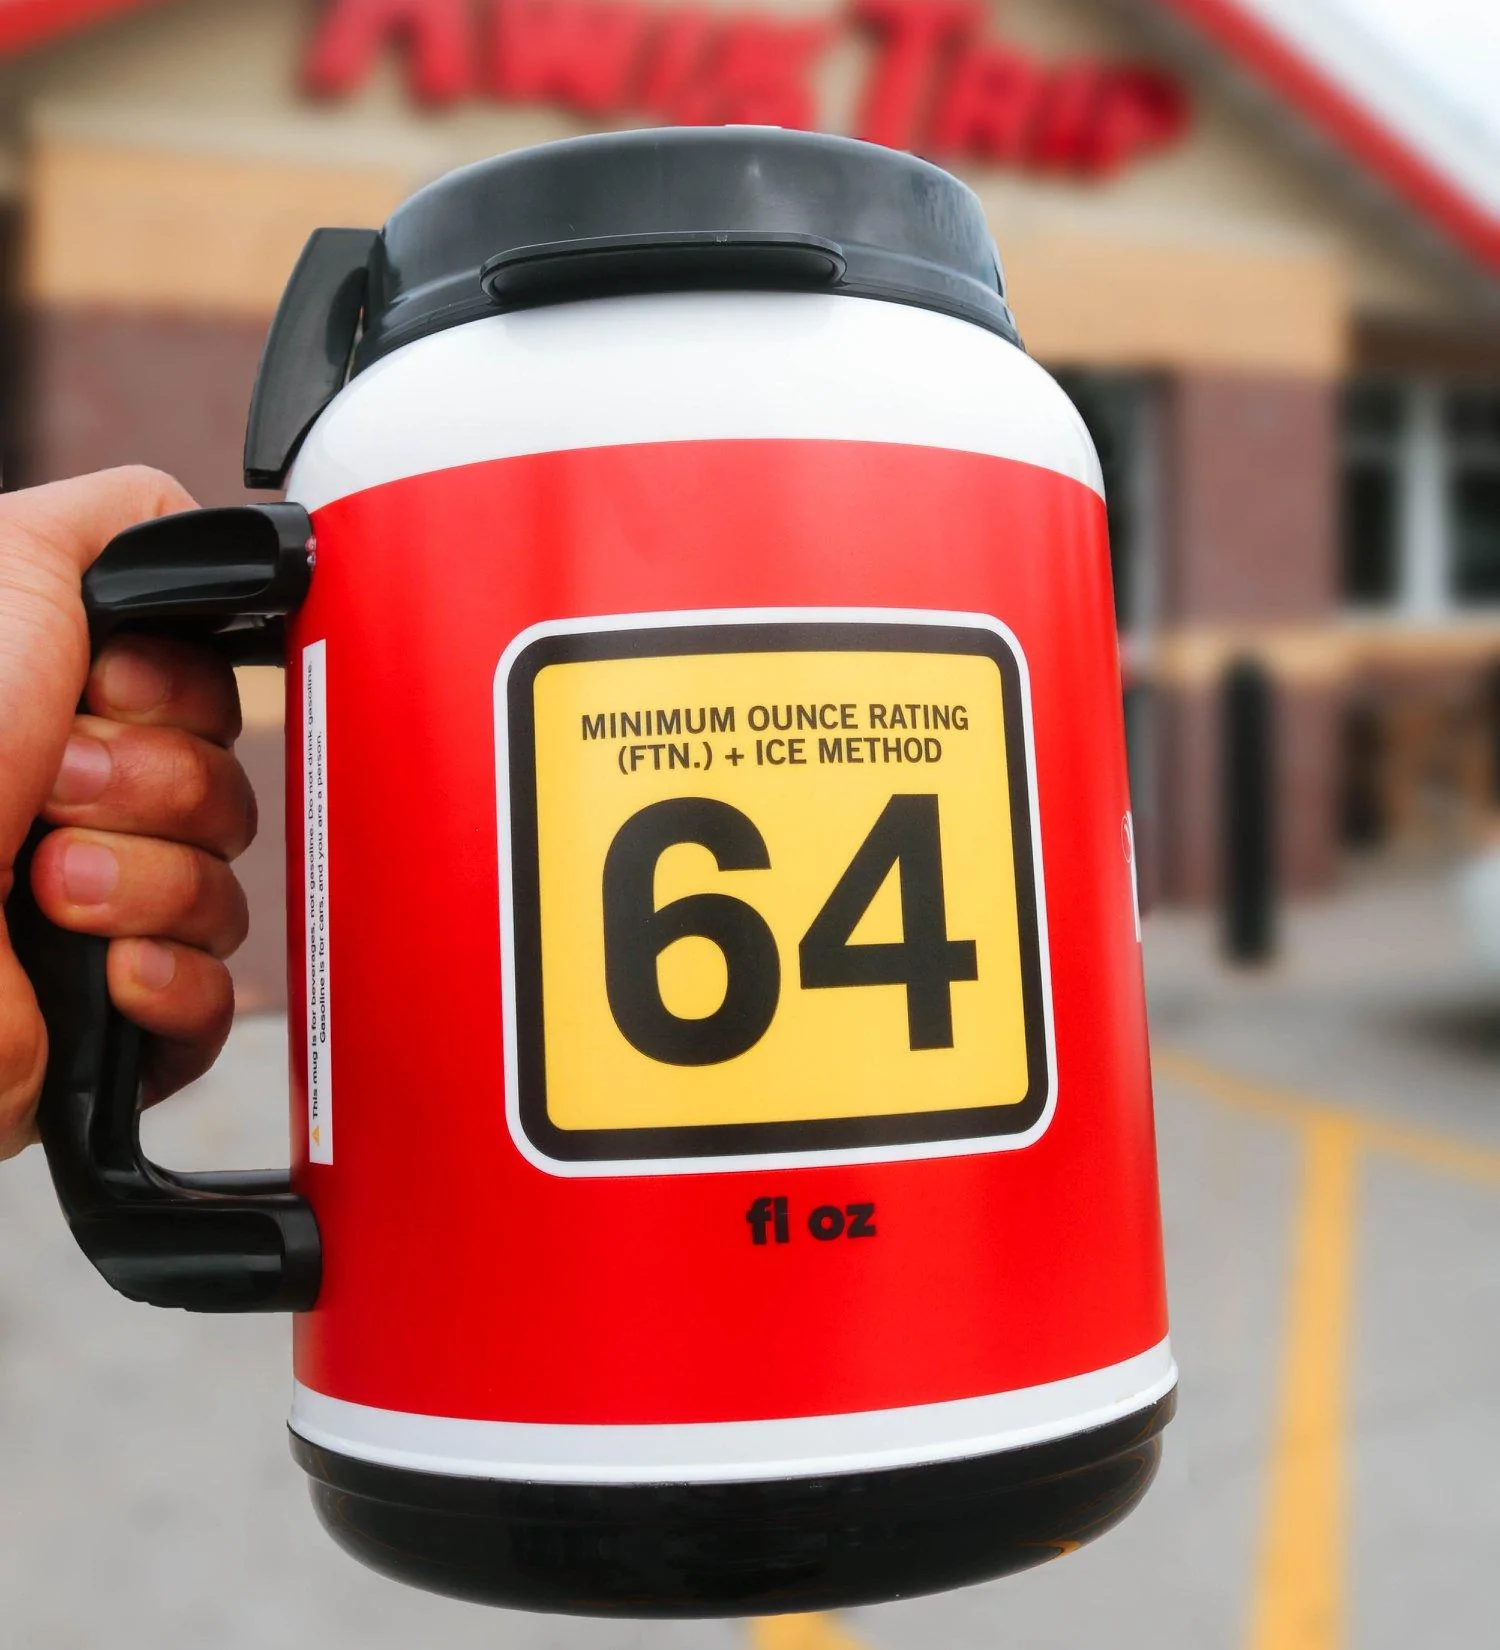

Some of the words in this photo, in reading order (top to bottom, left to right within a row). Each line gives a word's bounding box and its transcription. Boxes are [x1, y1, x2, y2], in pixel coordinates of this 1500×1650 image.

[581, 706, 736, 740] MINIMUM
[747, 703, 859, 731] OUNCE
[869, 703, 969, 731] RATING
[618, 741, 713, 774] (FTN.)
[725, 747, 745, 766] +
[756, 738, 808, 765] ICE
[818, 736, 942, 763] METHOD
[308, 798, 314, 819] Do
[308, 823, 316, 889] gasoline.
[602, 793, 978, 1067] 64
[746, 1196, 789, 1245] fl
[808, 1203, 877, 1240] oz
